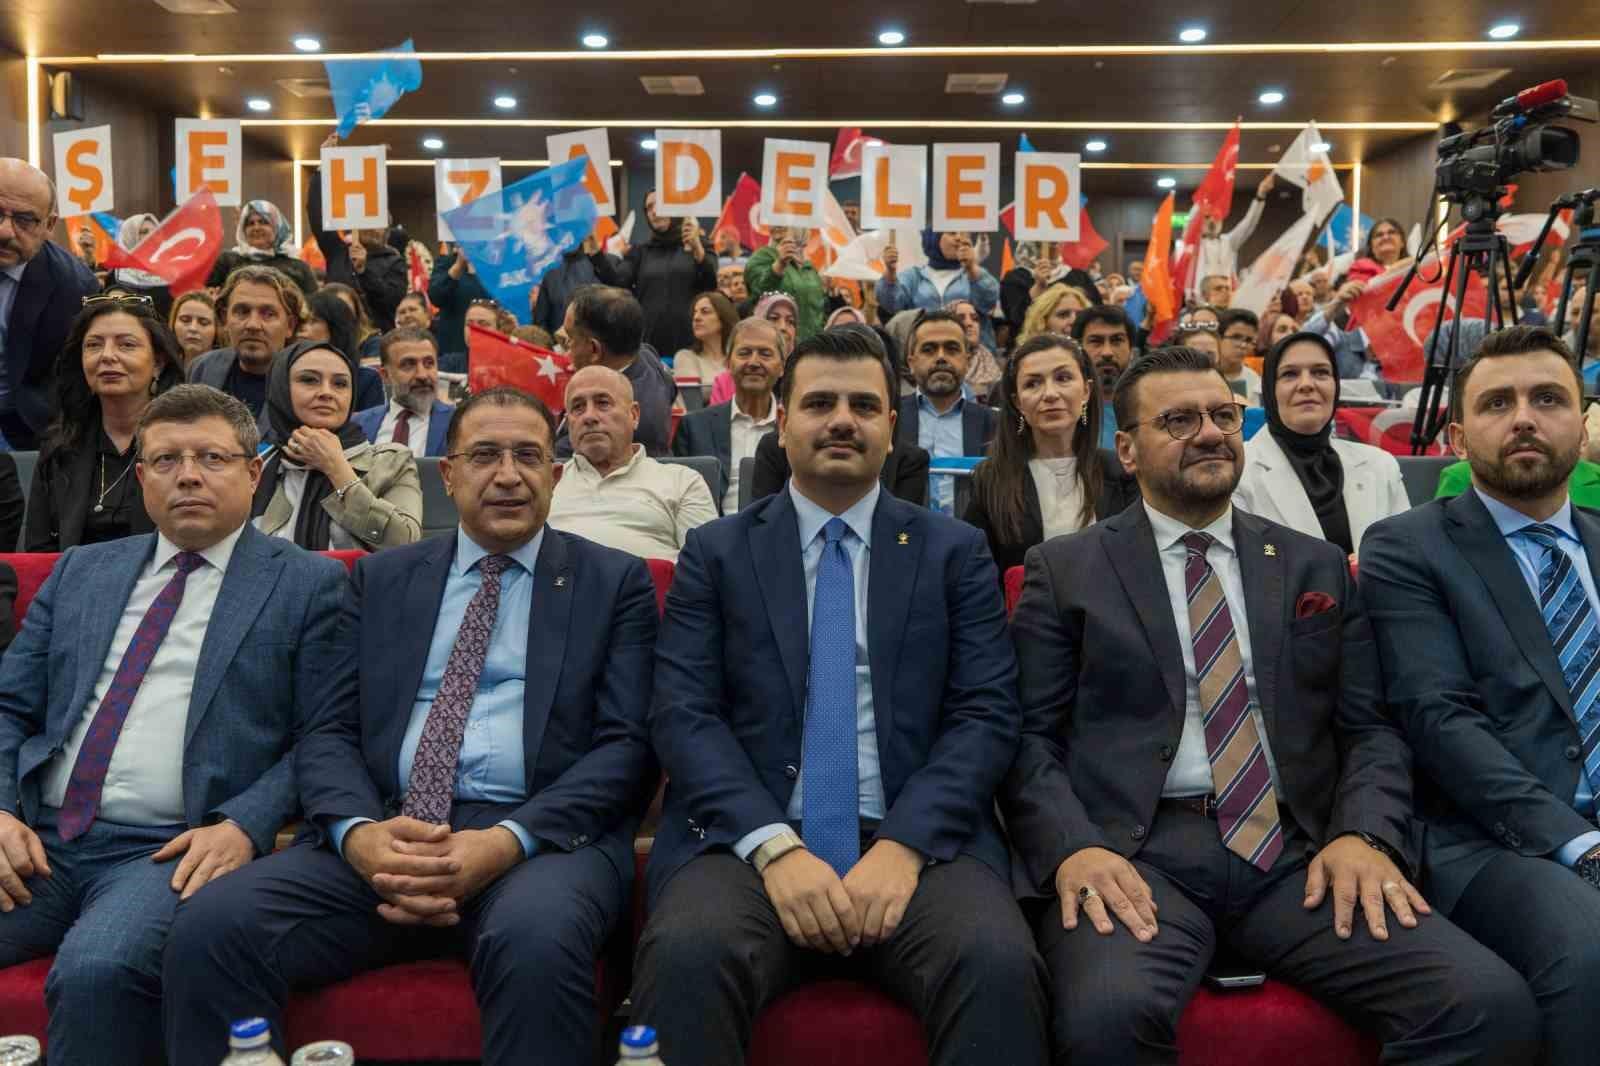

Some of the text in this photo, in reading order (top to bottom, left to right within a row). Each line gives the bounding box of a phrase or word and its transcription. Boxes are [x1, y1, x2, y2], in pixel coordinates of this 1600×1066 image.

[66, 139, 103, 210] Ş
[188, 131, 229, 194] E
[330, 158, 379, 218] H
[663, 142, 714, 205] D
[774, 152, 816, 216] E
[875, 157, 913, 218] L
[946, 155, 986, 220] E
[1024, 164, 1069, 230] R
